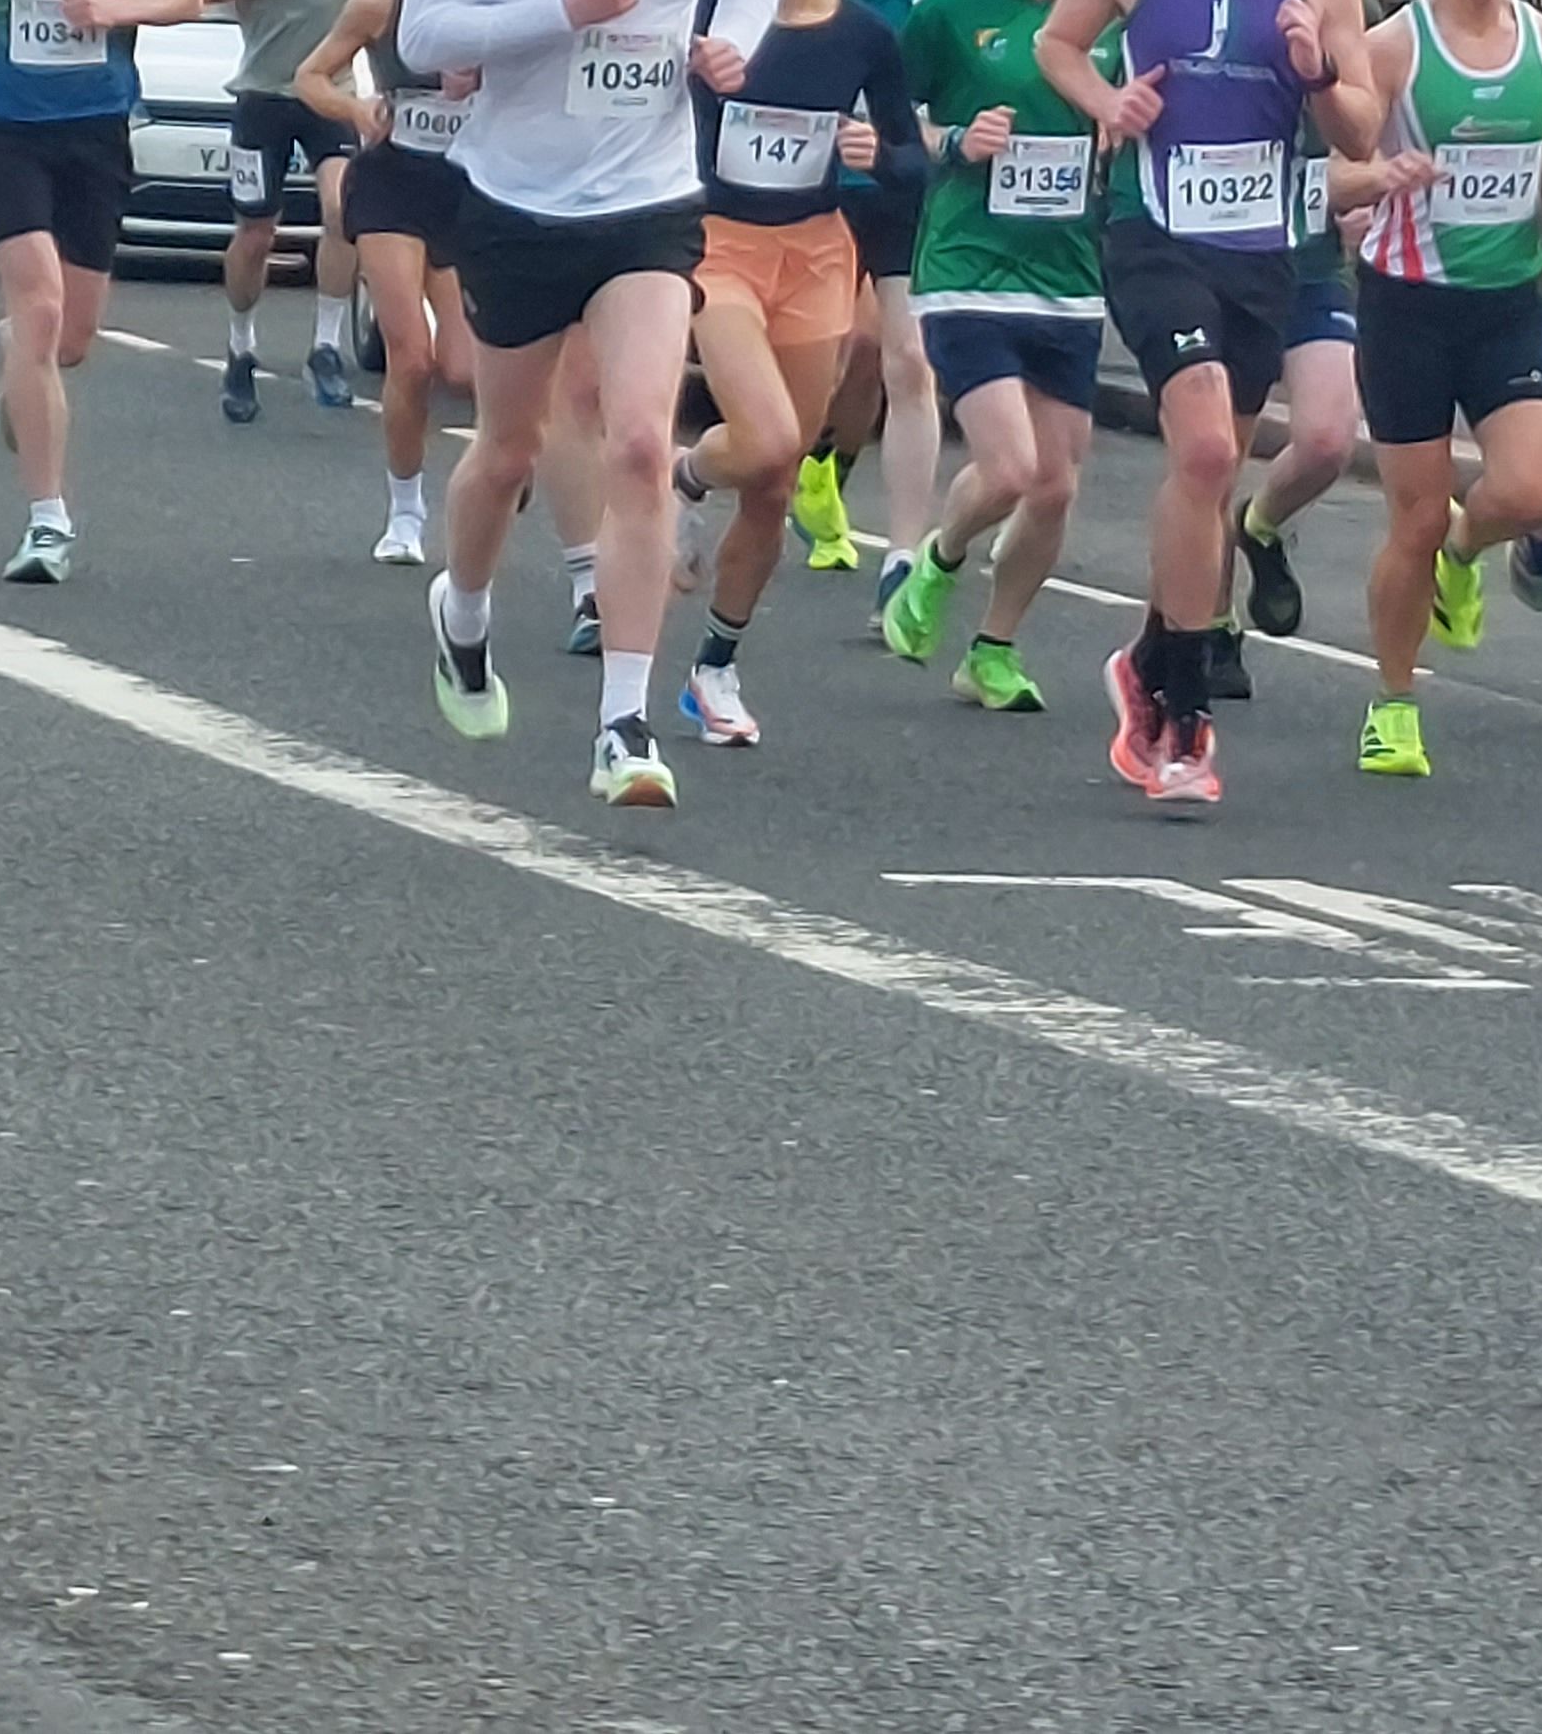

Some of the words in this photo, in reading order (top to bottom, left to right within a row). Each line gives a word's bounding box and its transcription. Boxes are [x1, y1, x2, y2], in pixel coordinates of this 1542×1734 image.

[581, 59, 674, 90] 10340
[749, 134, 809, 165] 147
[1179, 172, 1274, 206] 10322
[1441, 172, 1532, 199] 10247
